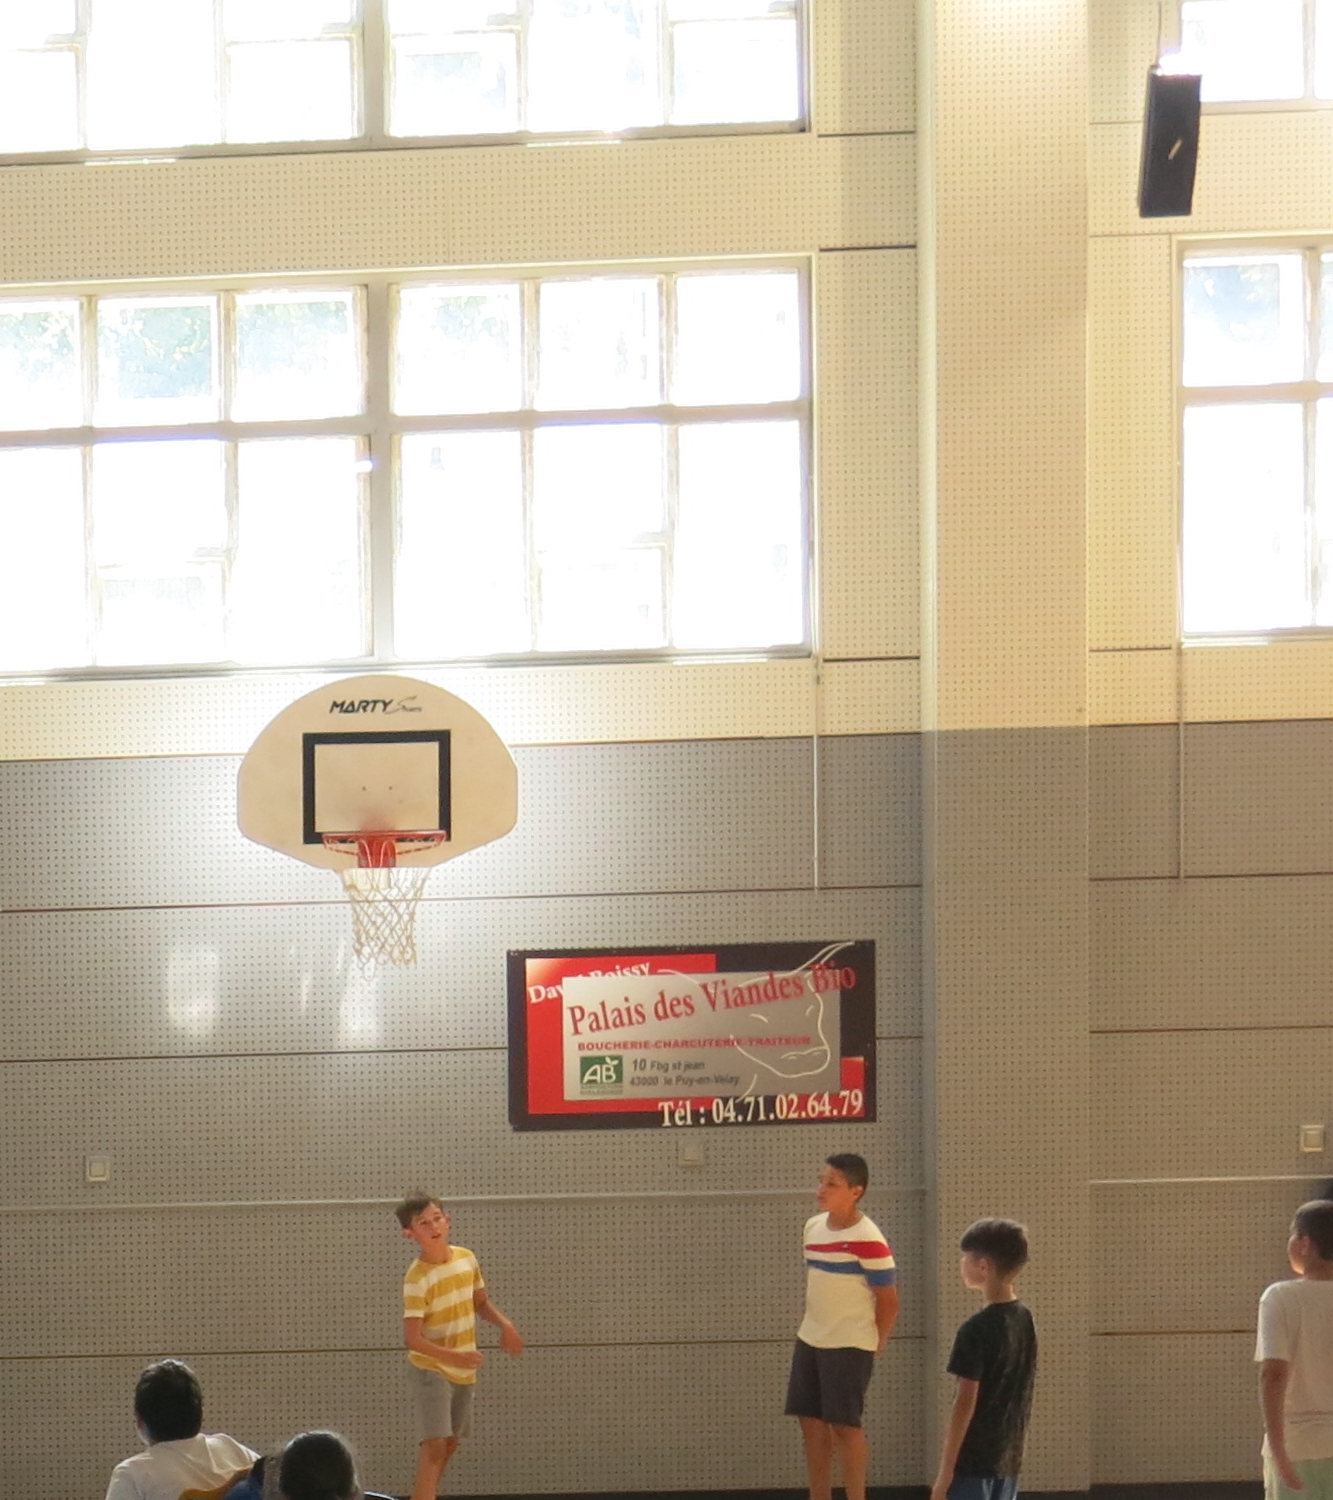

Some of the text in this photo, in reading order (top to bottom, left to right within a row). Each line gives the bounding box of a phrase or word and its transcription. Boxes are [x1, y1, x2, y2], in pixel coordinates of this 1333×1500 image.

[329, 699, 394, 714] MARTY
[568, 960, 857, 1036] Palais des Viandes Bio
[583, 1063, 617, 1084] AB
[632, 1058, 647, 1071] 10
[658, 1098, 692, 1127] Tél
[712, 1088, 863, 1124] 04.71.02.64.79
